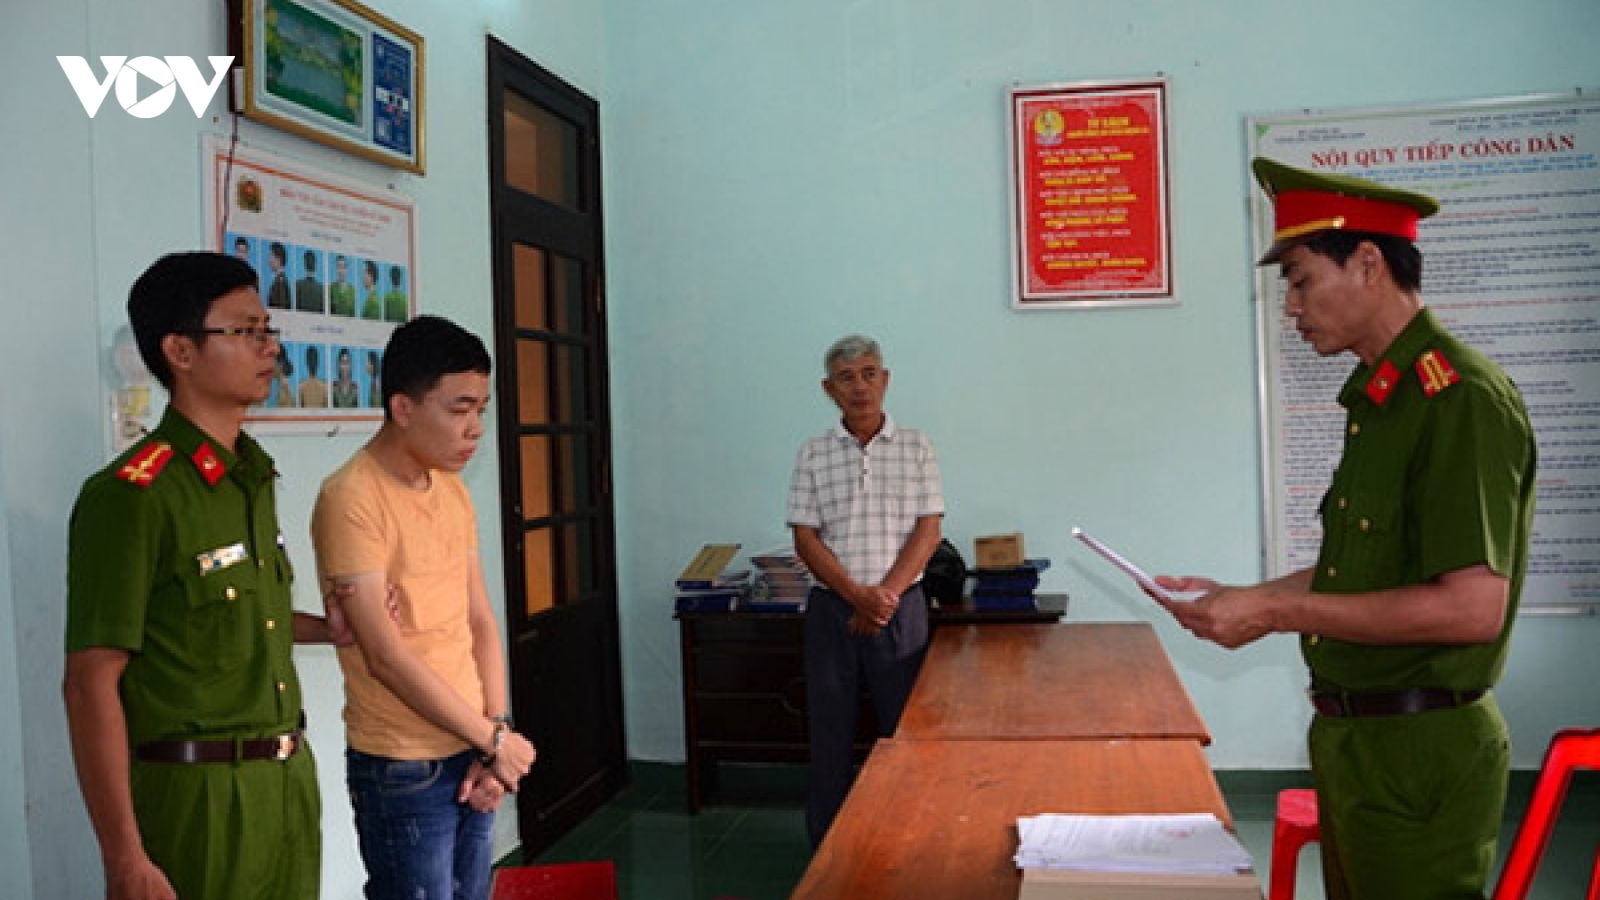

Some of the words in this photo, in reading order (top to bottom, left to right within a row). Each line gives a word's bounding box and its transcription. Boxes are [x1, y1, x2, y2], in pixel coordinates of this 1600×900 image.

[1354, 148, 1397, 168] QUY
[1403, 137, 1454, 162] TIẾP
[1459, 136, 1521, 158] CÔNG
[1527, 131, 1576, 153] DÂN
